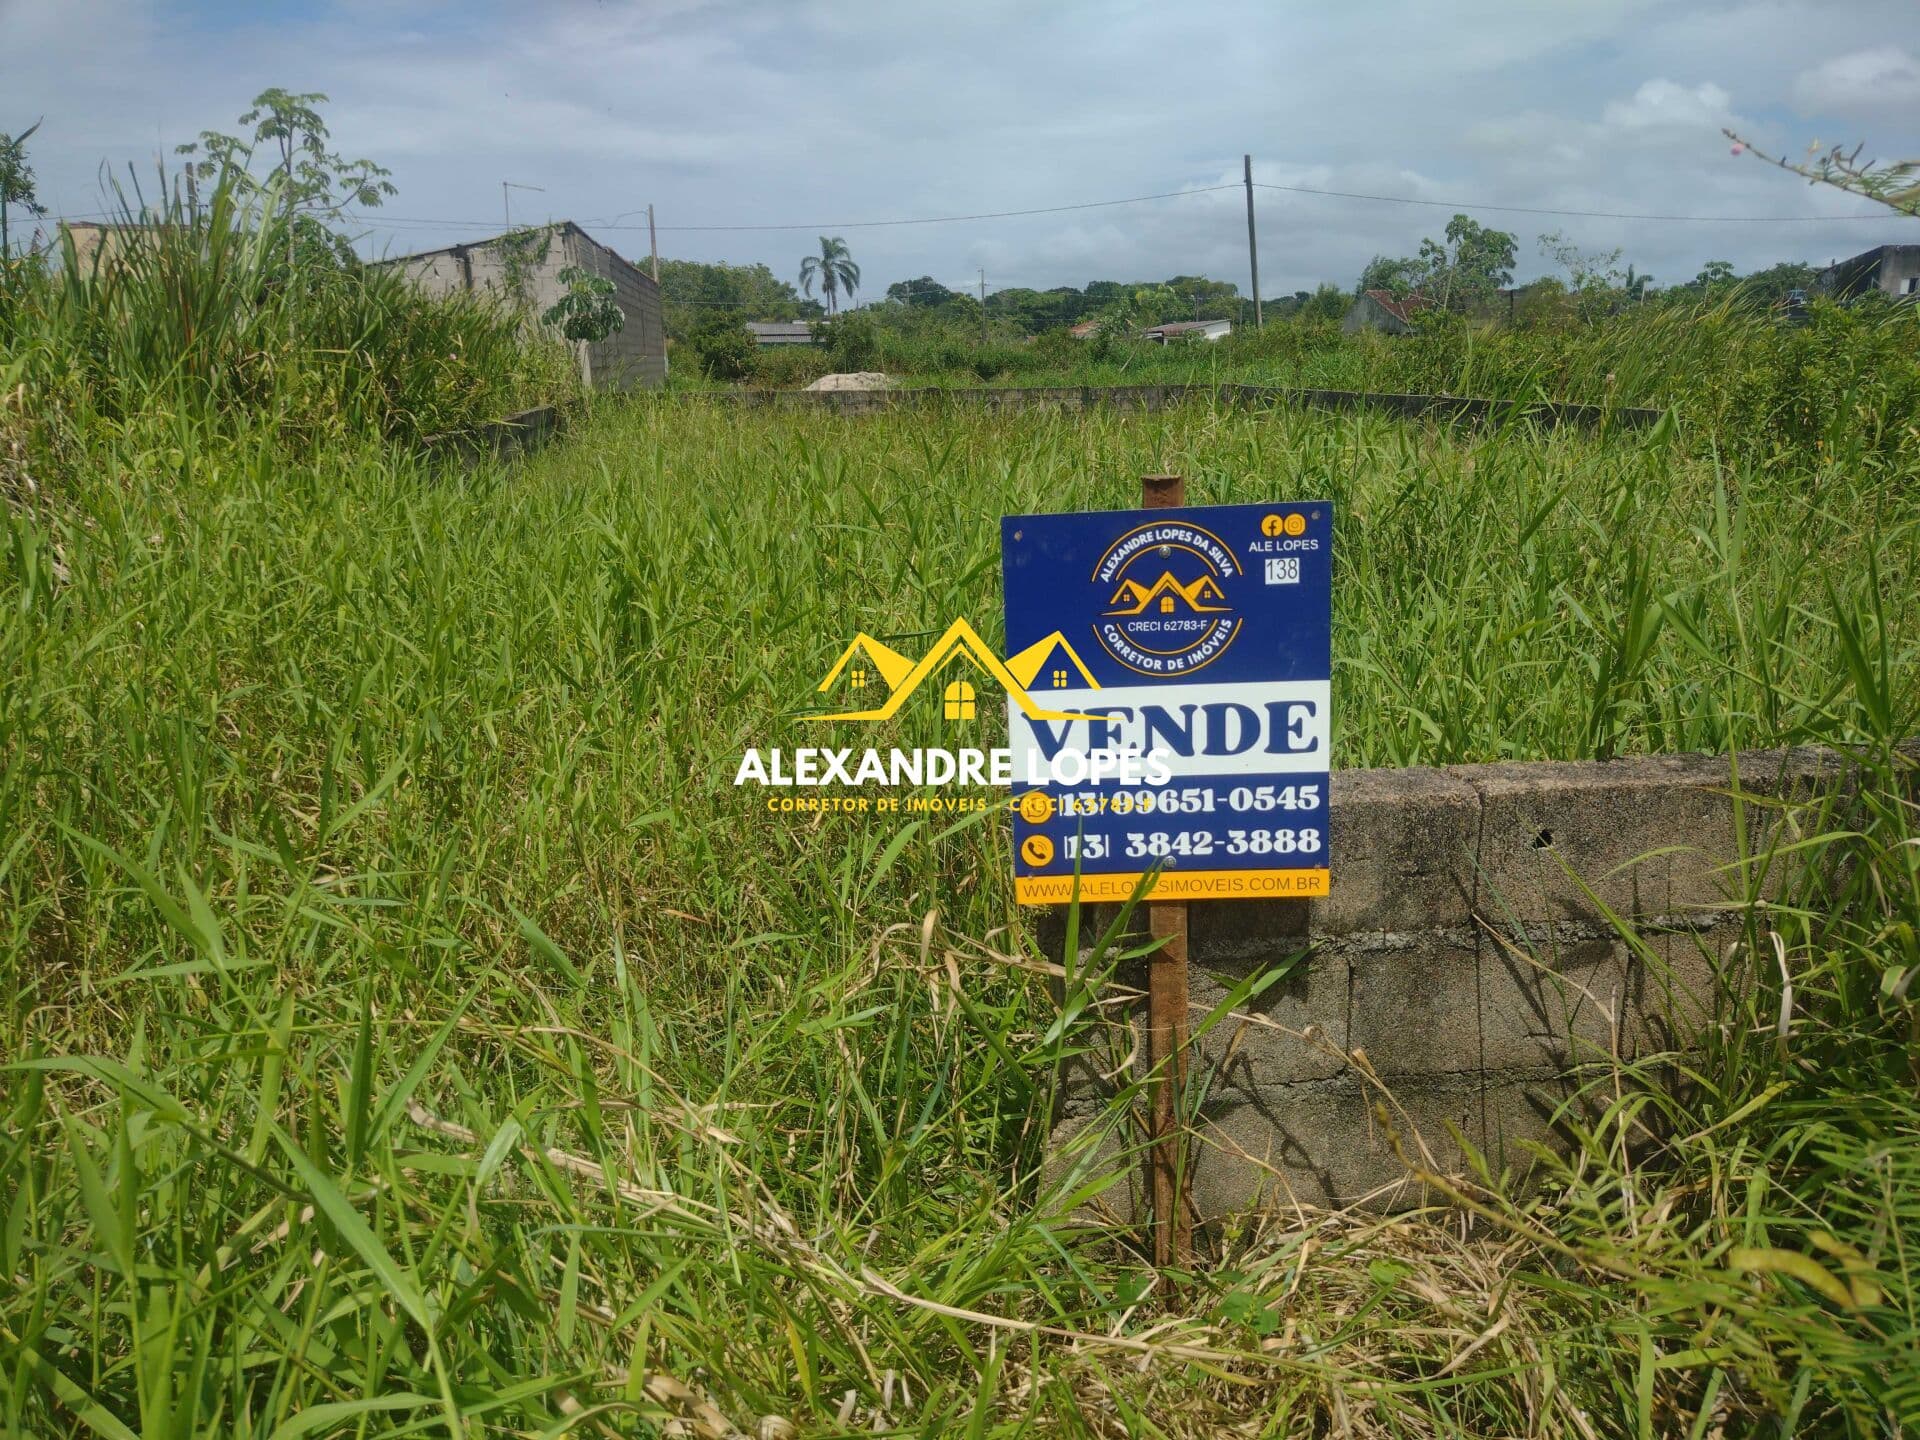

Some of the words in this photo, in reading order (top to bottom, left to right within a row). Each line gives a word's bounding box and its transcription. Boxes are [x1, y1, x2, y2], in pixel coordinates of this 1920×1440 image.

[1100, 531, 1154, 583] ALEXANDRE
[1155, 528, 1193, 543] LOPES
[1192, 535, 1210, 551] DA
[1208, 546, 1234, 578] SILVA
[1248, 541, 1273, 553] ALE
[1276, 539, 1319, 551] LOPES
[1266, 558, 1298, 581] 138
[1127, 621, 1161, 632] CRECI
[1163, 619, 1208, 631] 62783-F
[1103, 623, 1163, 671] CORRETOR
[1167, 660, 1185, 671] DE
[1187, 618, 1233, 666] IMÓVEIS
[1021, 700, 1319, 762] VENDE
[1112, 784, 1321, 815] 99651-0545
[1125, 828, 1322, 858] 3842-3888
[1023, 876, 1321, 898] WWWALELOSIMOVEIS.COM.BR
